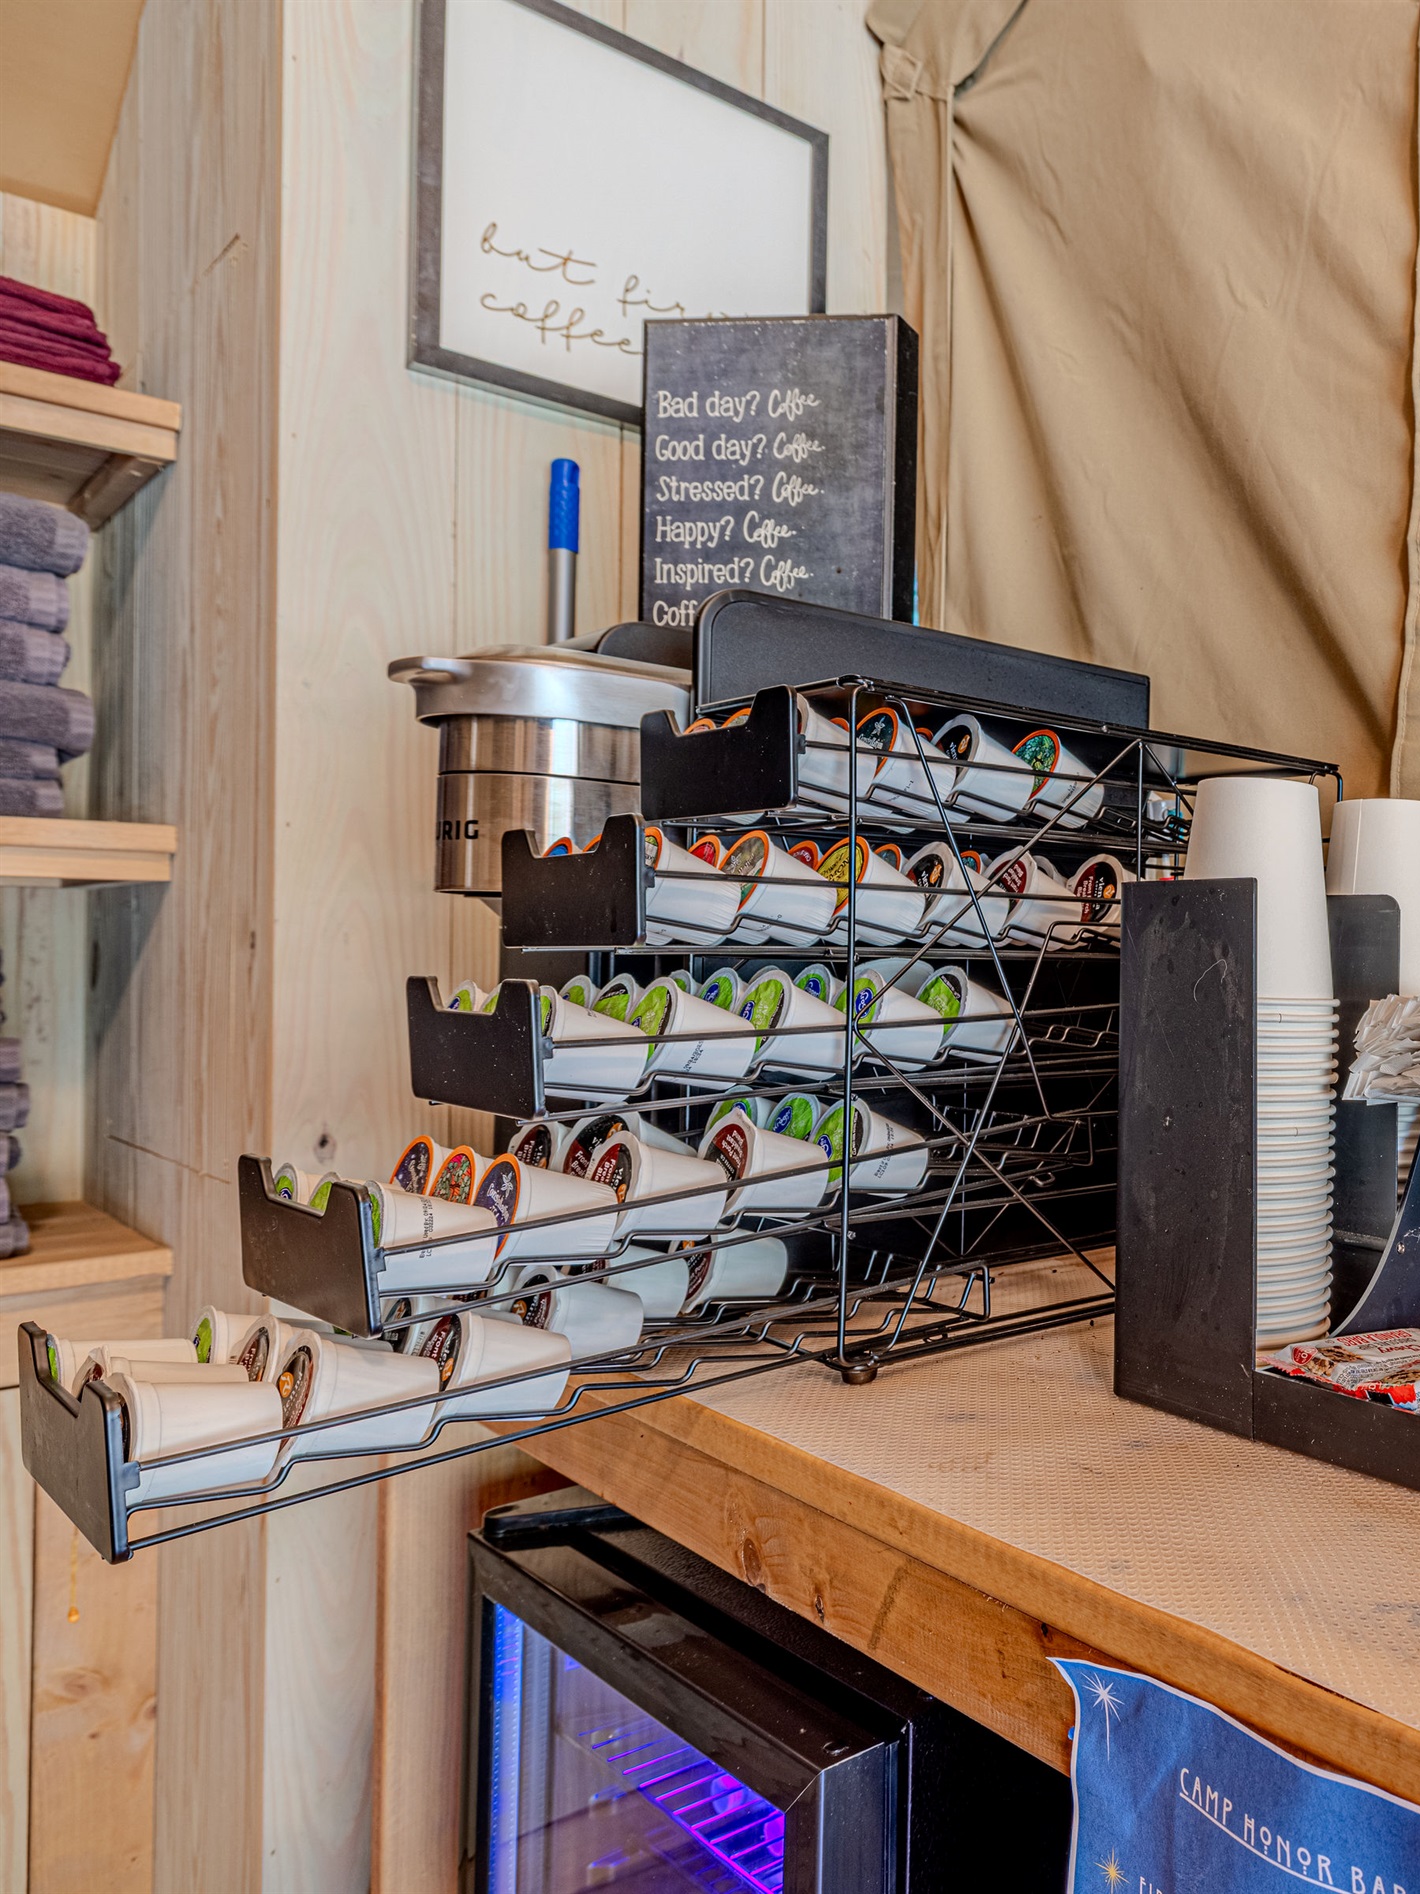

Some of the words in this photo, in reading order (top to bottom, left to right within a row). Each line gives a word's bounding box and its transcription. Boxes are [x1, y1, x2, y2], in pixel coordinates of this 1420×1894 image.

[481, 222, 597, 285] but
[617, 274, 685, 317] fir
[657, 390, 699, 418] Bad
[705, 390, 760, 423] day?
[655, 434, 705, 461] Good
[712, 434, 767, 466] day?
[656, 474, 764, 502] Stressed?
[655, 515, 735, 549] Happy?
[654, 557, 755, 591] Inspired?
[652, 599, 699, 627] Coff
[1337, 1335, 1367, 1347] BARS
[1180, 1767, 1233, 1826] CAMP
[1243, 1813, 1333, 1886] HONOR
